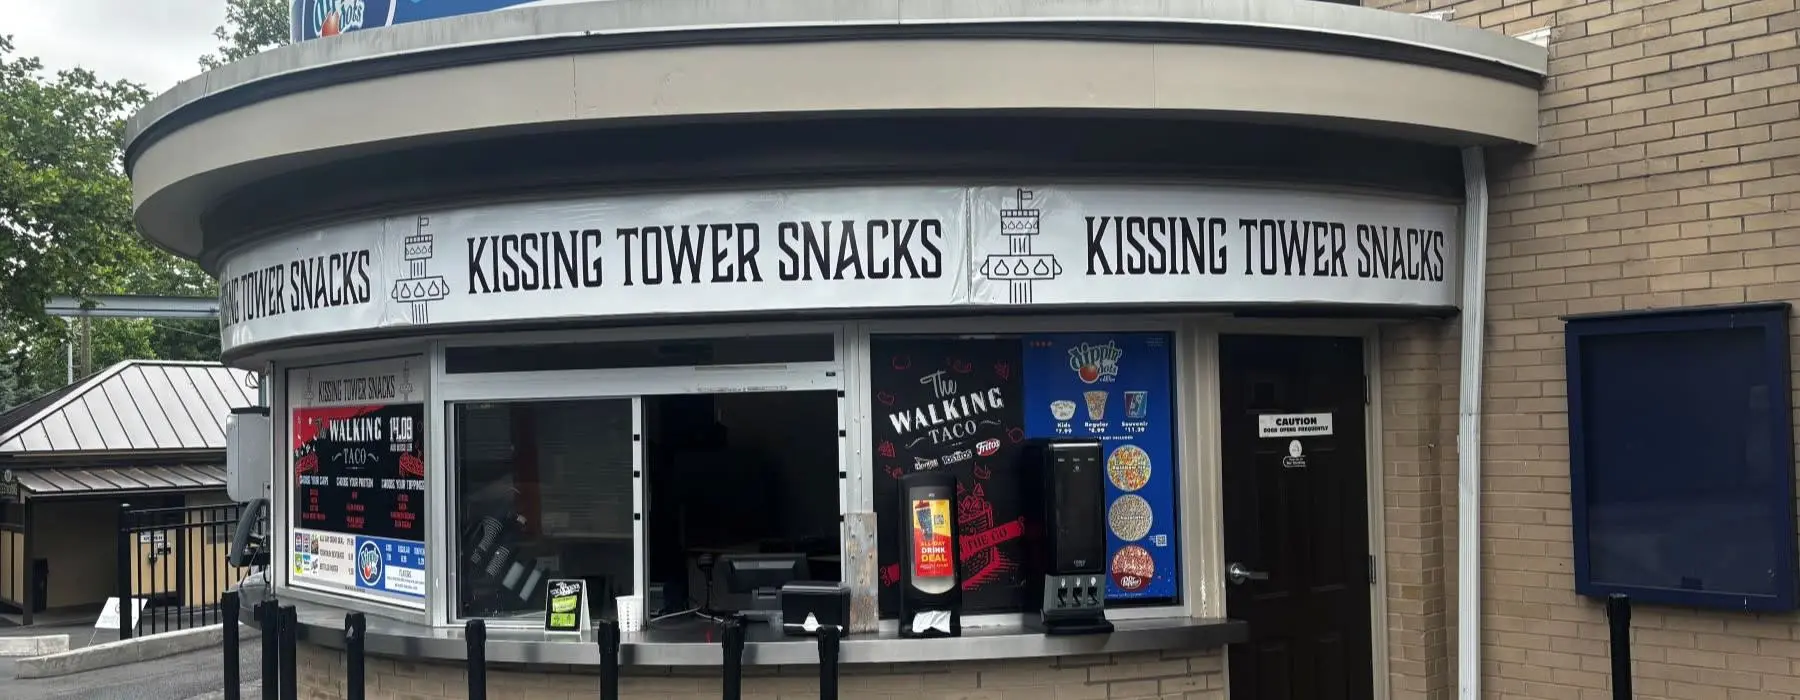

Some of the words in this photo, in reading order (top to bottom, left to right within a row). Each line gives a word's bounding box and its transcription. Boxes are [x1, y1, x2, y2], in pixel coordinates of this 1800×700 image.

[467, 229, 603, 295] KISSING
[616, 222, 763, 287] TOWER
[778, 218, 942, 283] SNACKS
[1085, 215, 1227, 276] KISSING
[1239, 218, 1348, 277] TOWER
[1356, 223, 1444, 283] SNACKS
[241, 263, 286, 321] TOWER
[290, 249, 371, 312] SNACKS
[318, 379, 341, 403] KISSING
[343, 377, 366, 401] TOWER
[368, 374, 395, 400] SNACKS
[919, 369, 957, 399] The
[888, 386, 1005, 435] WALKING
[1275, 417, 1317, 426] CAUTION
[329, 417, 382, 442] WALKING
[928, 419, 977, 445] TACO
[1084, 421, 1108, 429] Regular
[343, 447, 367, 465] TACO
[975, 438, 1000, 456] Fritos
[968, 535, 989, 553] THE
[991, 526, 1008, 542] GO
[921, 554, 947, 562] DEAL
